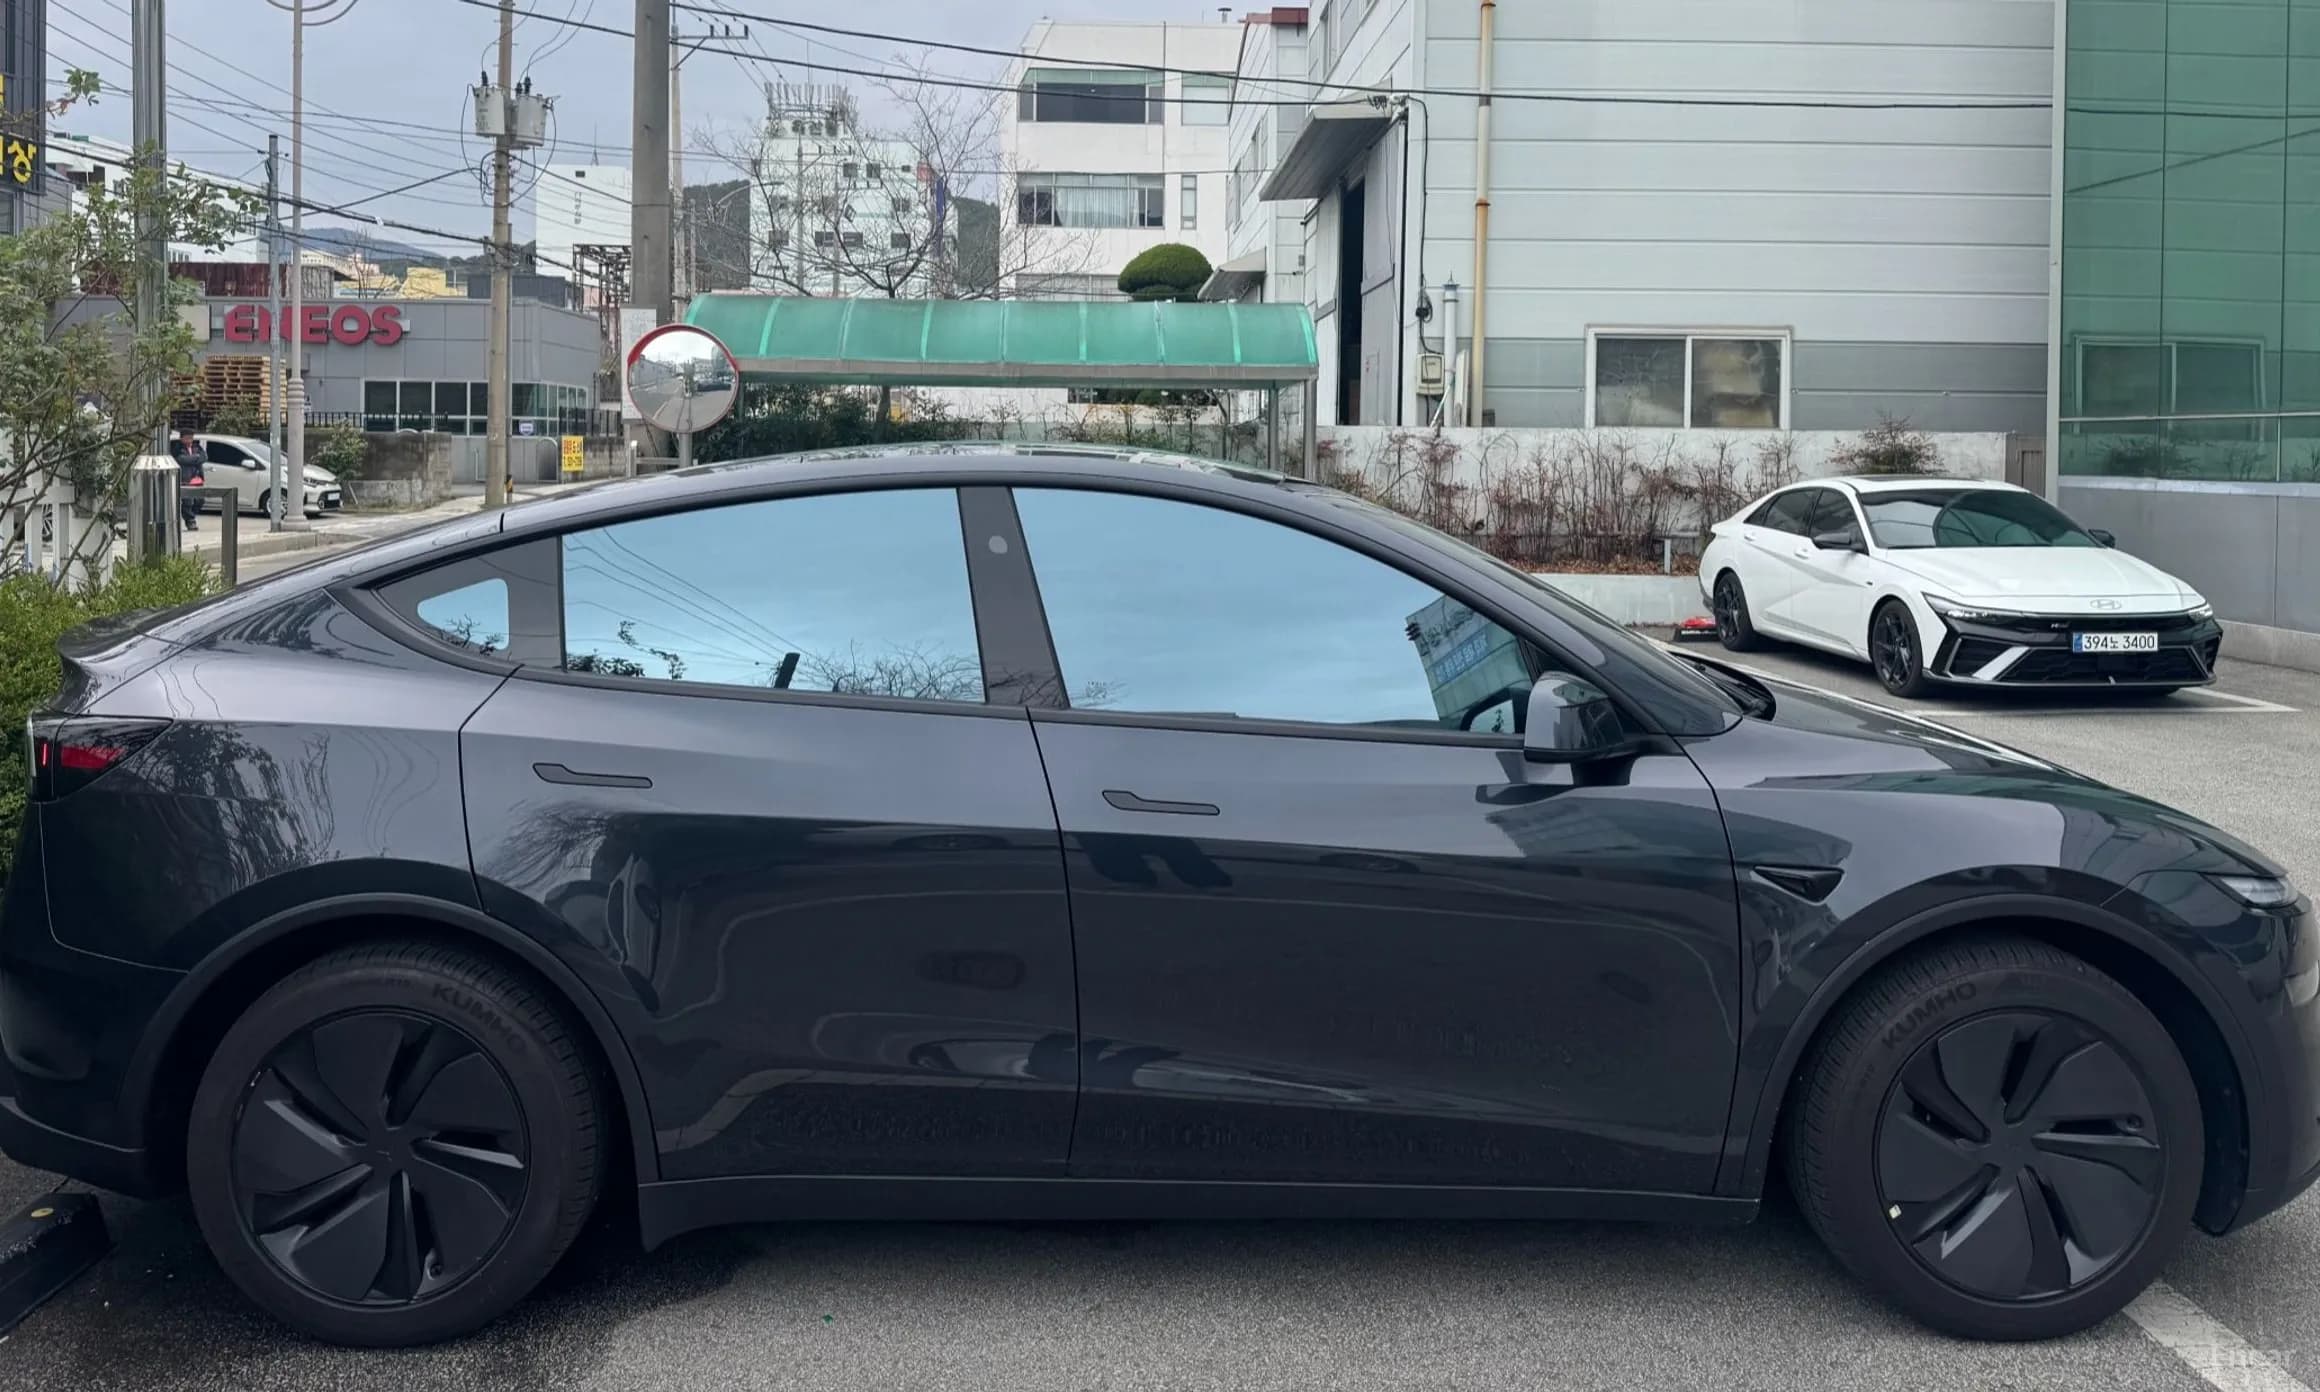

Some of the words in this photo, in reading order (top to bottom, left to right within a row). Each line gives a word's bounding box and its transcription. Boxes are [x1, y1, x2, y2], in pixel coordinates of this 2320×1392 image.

[224, 304, 403, 345] ENEOS
[2084, 635, 2119, 650] 394노
[2123, 635, 2155, 650] 3400
[432, 983, 527, 1055] KUMHO
[1881, 982, 1977, 1049] KUMHO
